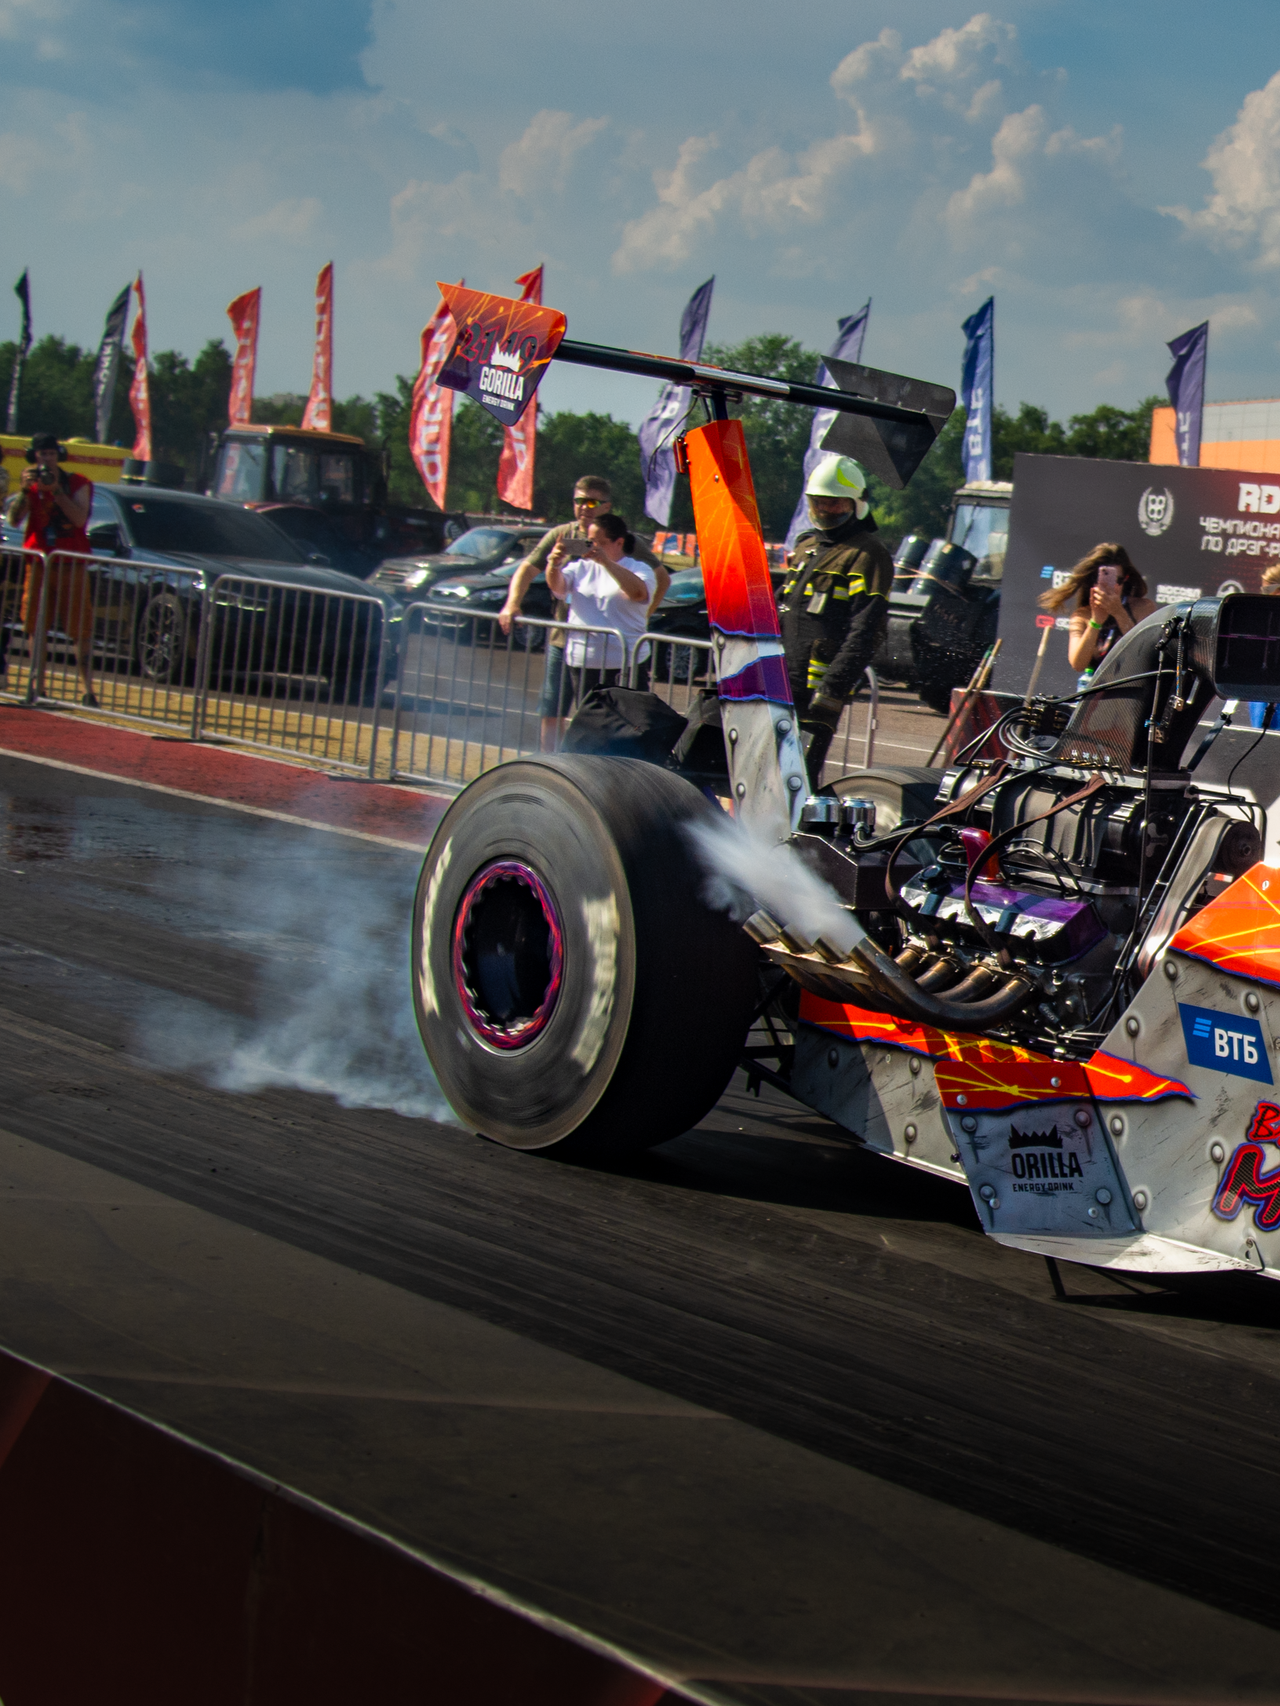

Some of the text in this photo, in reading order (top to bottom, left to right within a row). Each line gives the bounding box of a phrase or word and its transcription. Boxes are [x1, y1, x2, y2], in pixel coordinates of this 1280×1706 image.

[479, 366, 524, 401] GORILLA
[500, 399, 515, 411] DRINK
[1201, 535, 1223, 552] ПО
[1214, 1027, 1259, 1065] ВТБ
[1011, 1152, 1084, 1179] ORILLA
[1012, 1182, 1075, 1192] ENERGY DRINK
